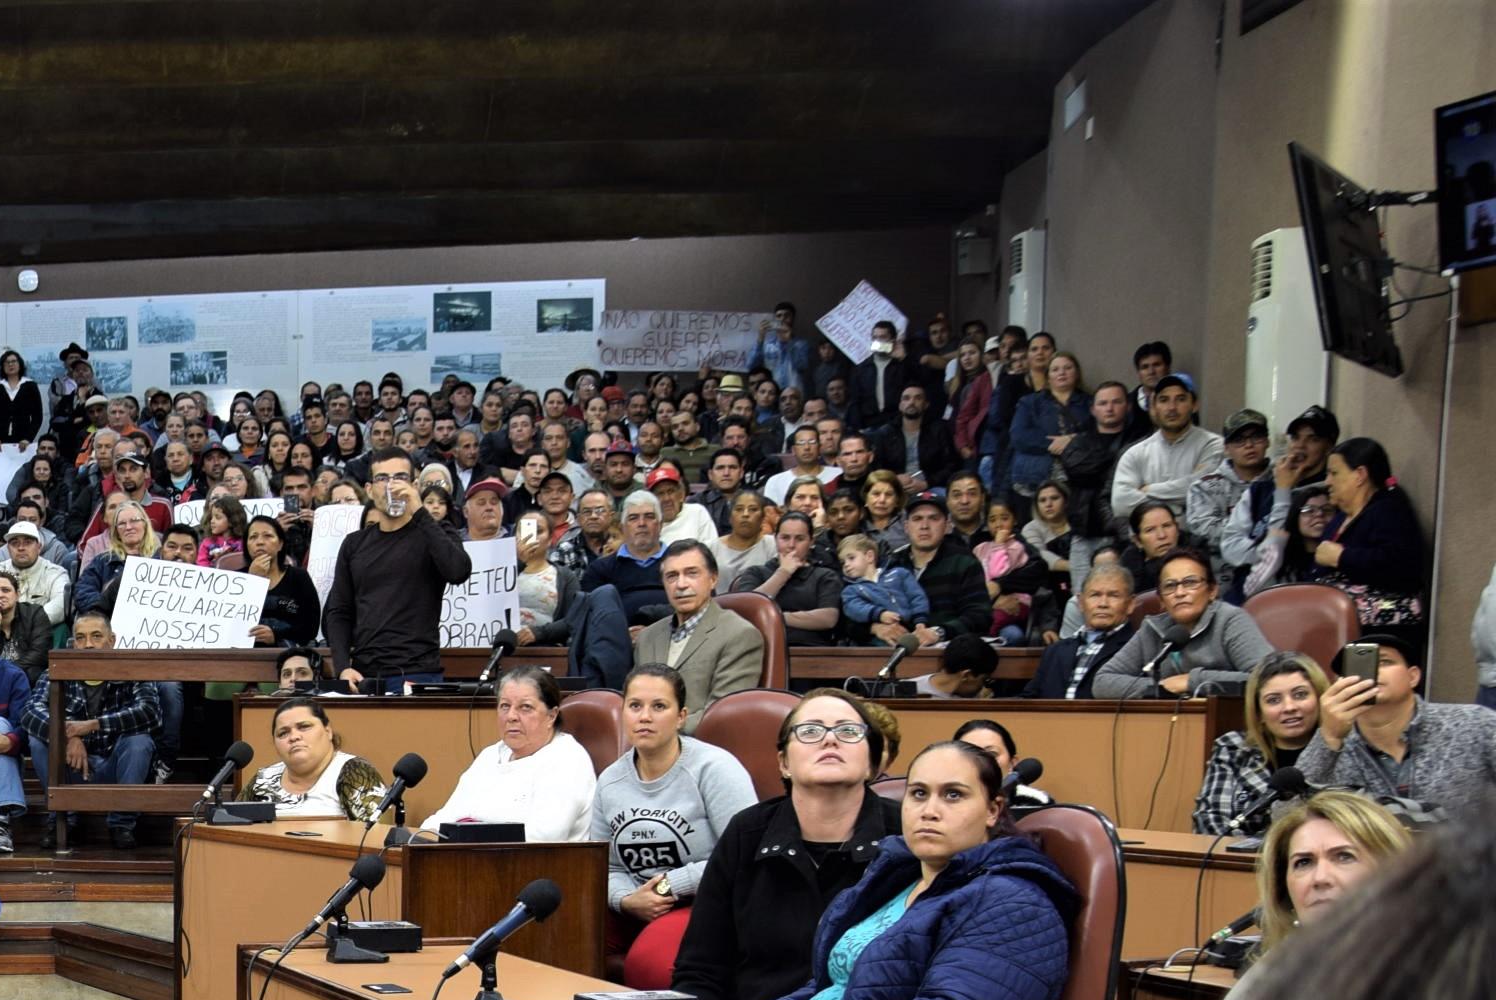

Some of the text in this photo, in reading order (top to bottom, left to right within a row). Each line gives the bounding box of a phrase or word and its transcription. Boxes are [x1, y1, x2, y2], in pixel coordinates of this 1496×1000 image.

[649, 312, 753, 331] QUEREMOS
[642, 331, 722, 348] GUERRA
[600, 348, 747, 368] QUEREMOS MORA
[135, 562, 247, 596] QUEREMOS
[127, 586, 260, 623] REGULARIZAR
[139, 617, 223, 644] NOSSAS
[630, 807, 670, 818] YORK
[667, 810, 695, 837] CITY
[623, 846, 675, 870] 285
